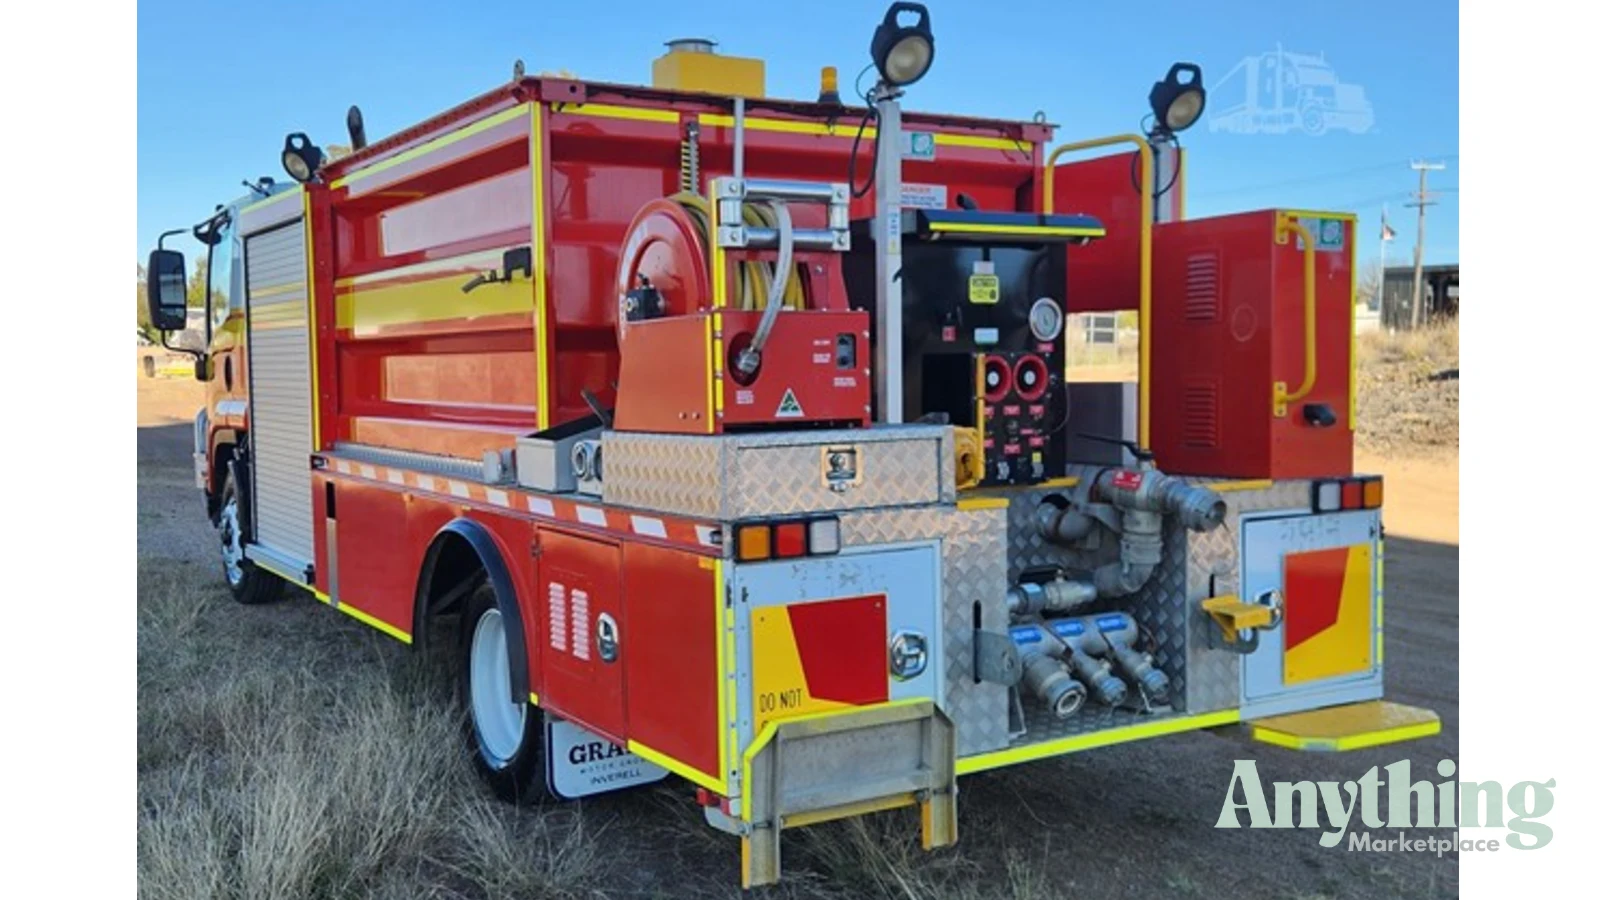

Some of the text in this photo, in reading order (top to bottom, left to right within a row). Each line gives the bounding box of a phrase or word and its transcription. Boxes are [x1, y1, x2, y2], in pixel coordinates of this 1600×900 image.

[759, 687, 803, 713] DO NOT
[569, 741, 632, 765] GRA
